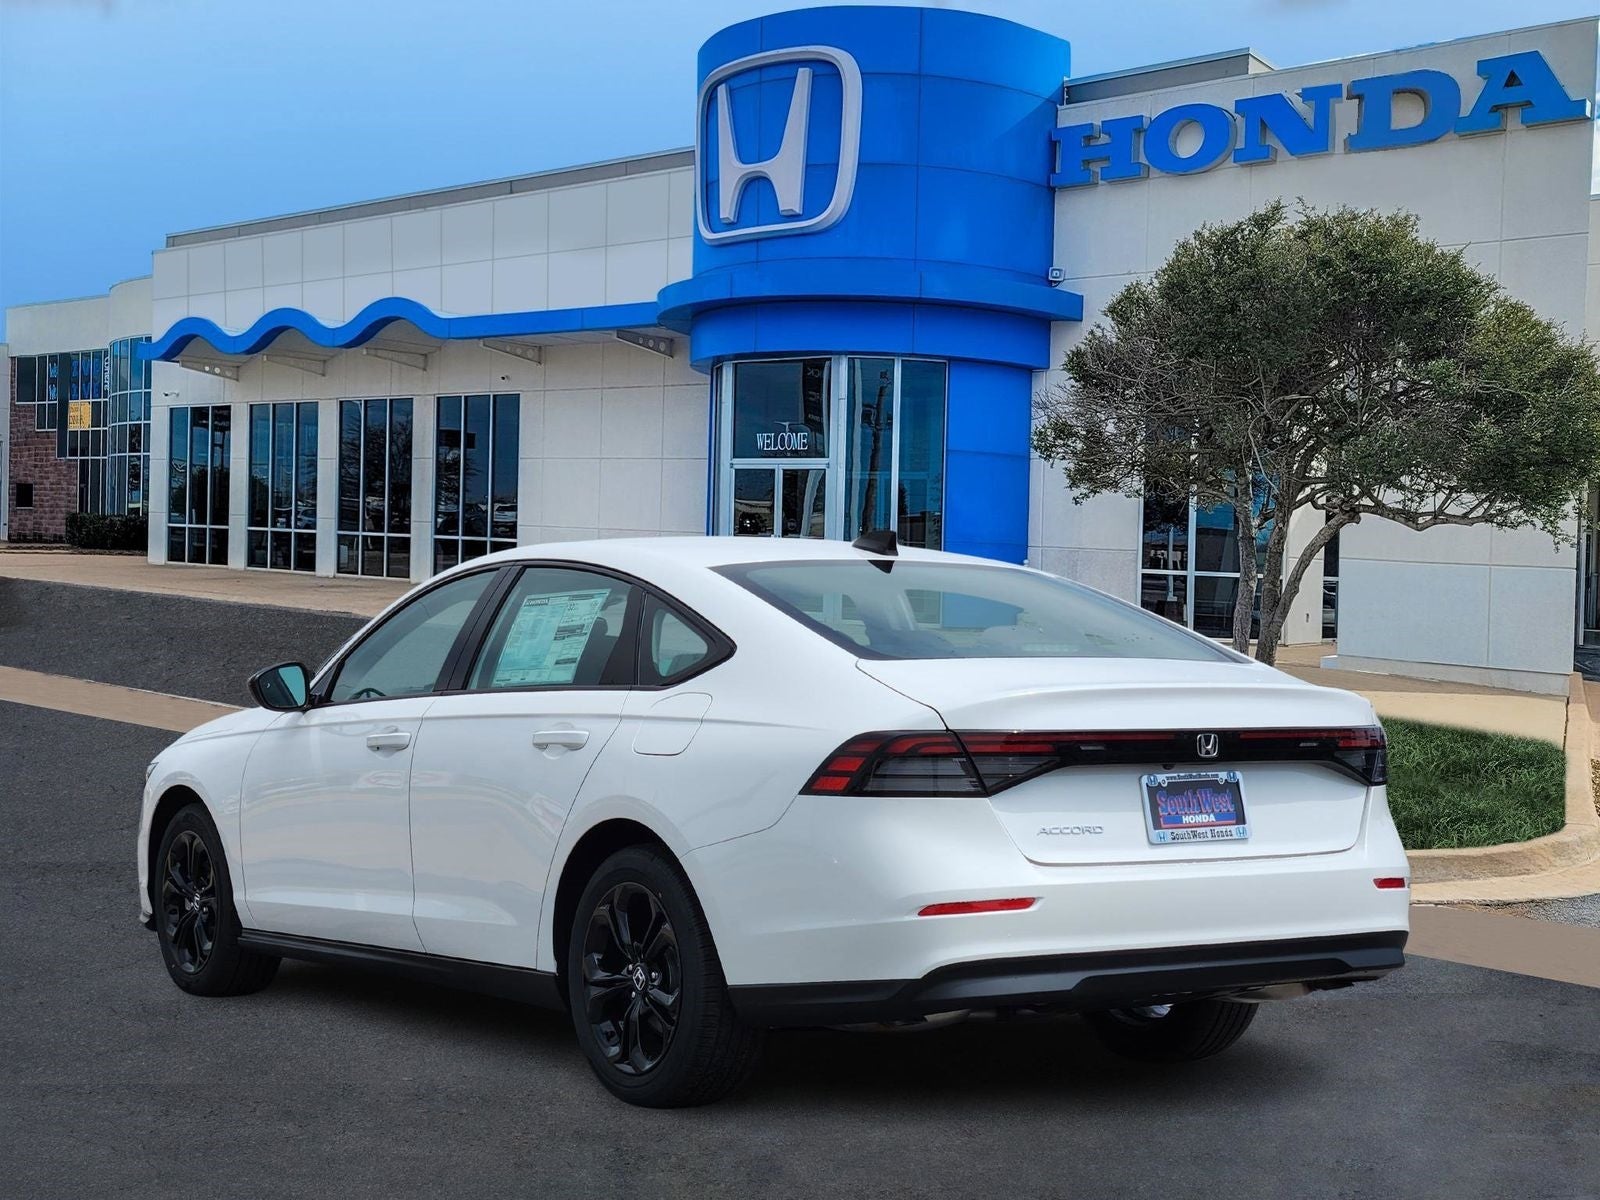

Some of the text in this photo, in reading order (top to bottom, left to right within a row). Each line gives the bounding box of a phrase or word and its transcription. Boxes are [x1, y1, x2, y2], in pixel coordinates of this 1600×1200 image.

[1050, 50, 1592, 188] HONDA
[756, 432, 808, 451] WELCOME
[1156, 787, 1235, 815] SouthWest
[1182, 813, 1216, 824] HONDA
[1036, 825, 1104, 836] ACCORD
[1170, 828, 1234, 841] SouthWest Honda
